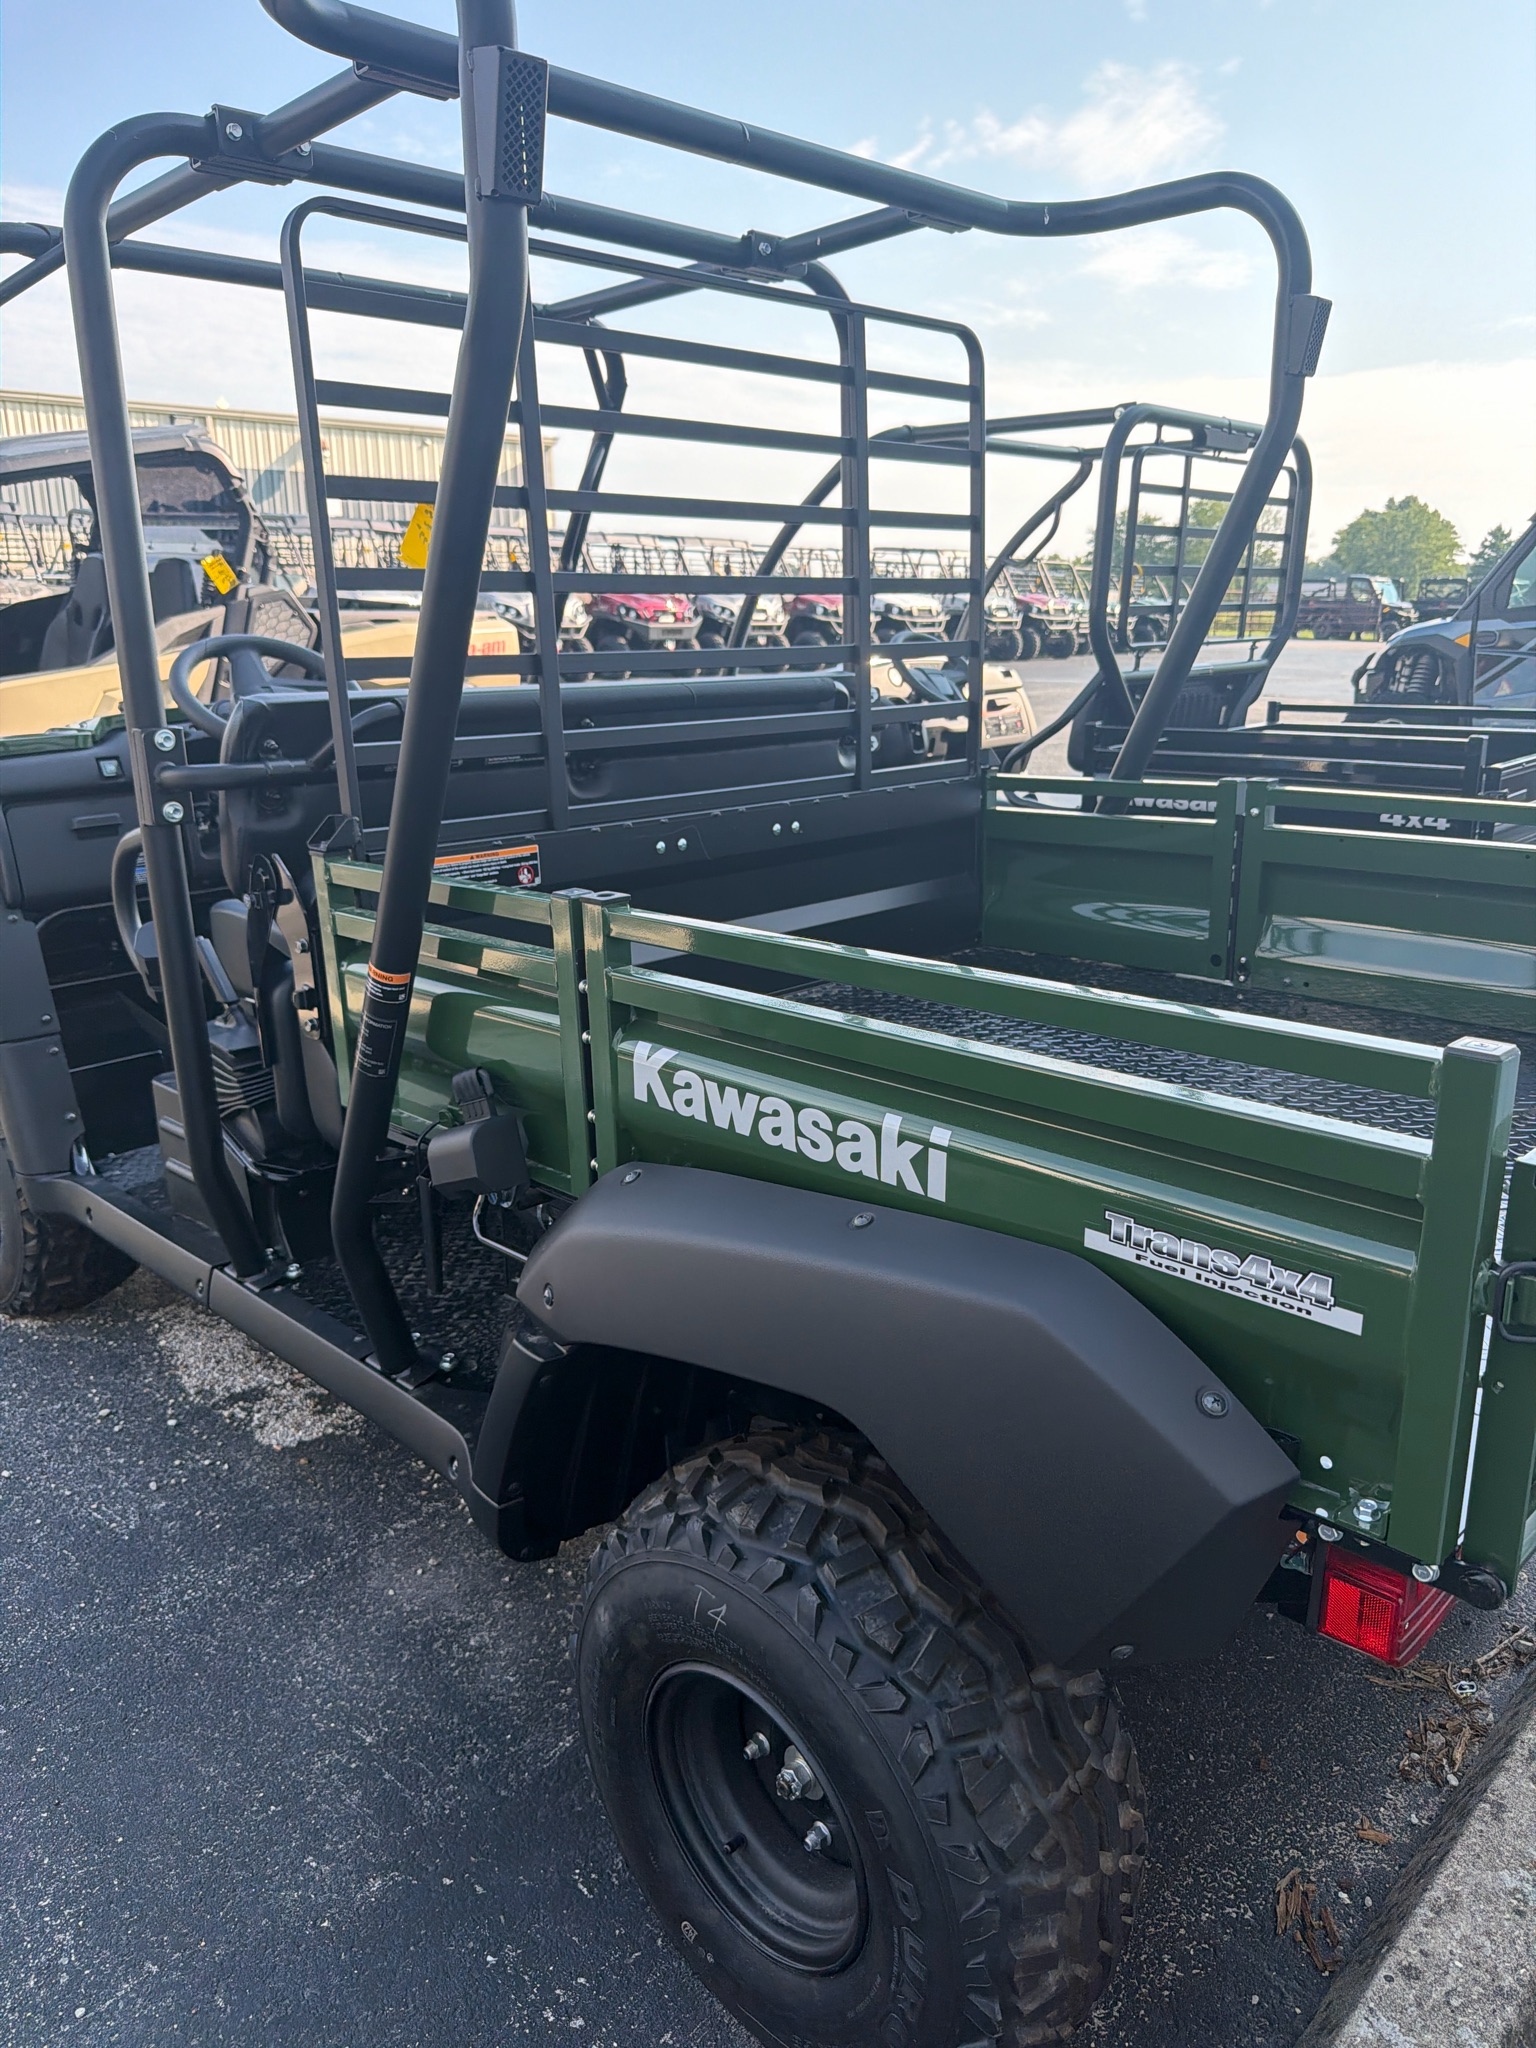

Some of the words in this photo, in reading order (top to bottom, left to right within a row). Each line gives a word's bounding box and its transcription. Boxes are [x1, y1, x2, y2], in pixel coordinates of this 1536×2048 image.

[1379, 813, 1451, 831] 4x4
[633, 1040, 952, 1203] Kawasaki
[1104, 1209, 1336, 1311] Trans4x4
[1135, 1253, 1186, 1276] Fuel
[1195, 1273, 1312, 1317] Injection
